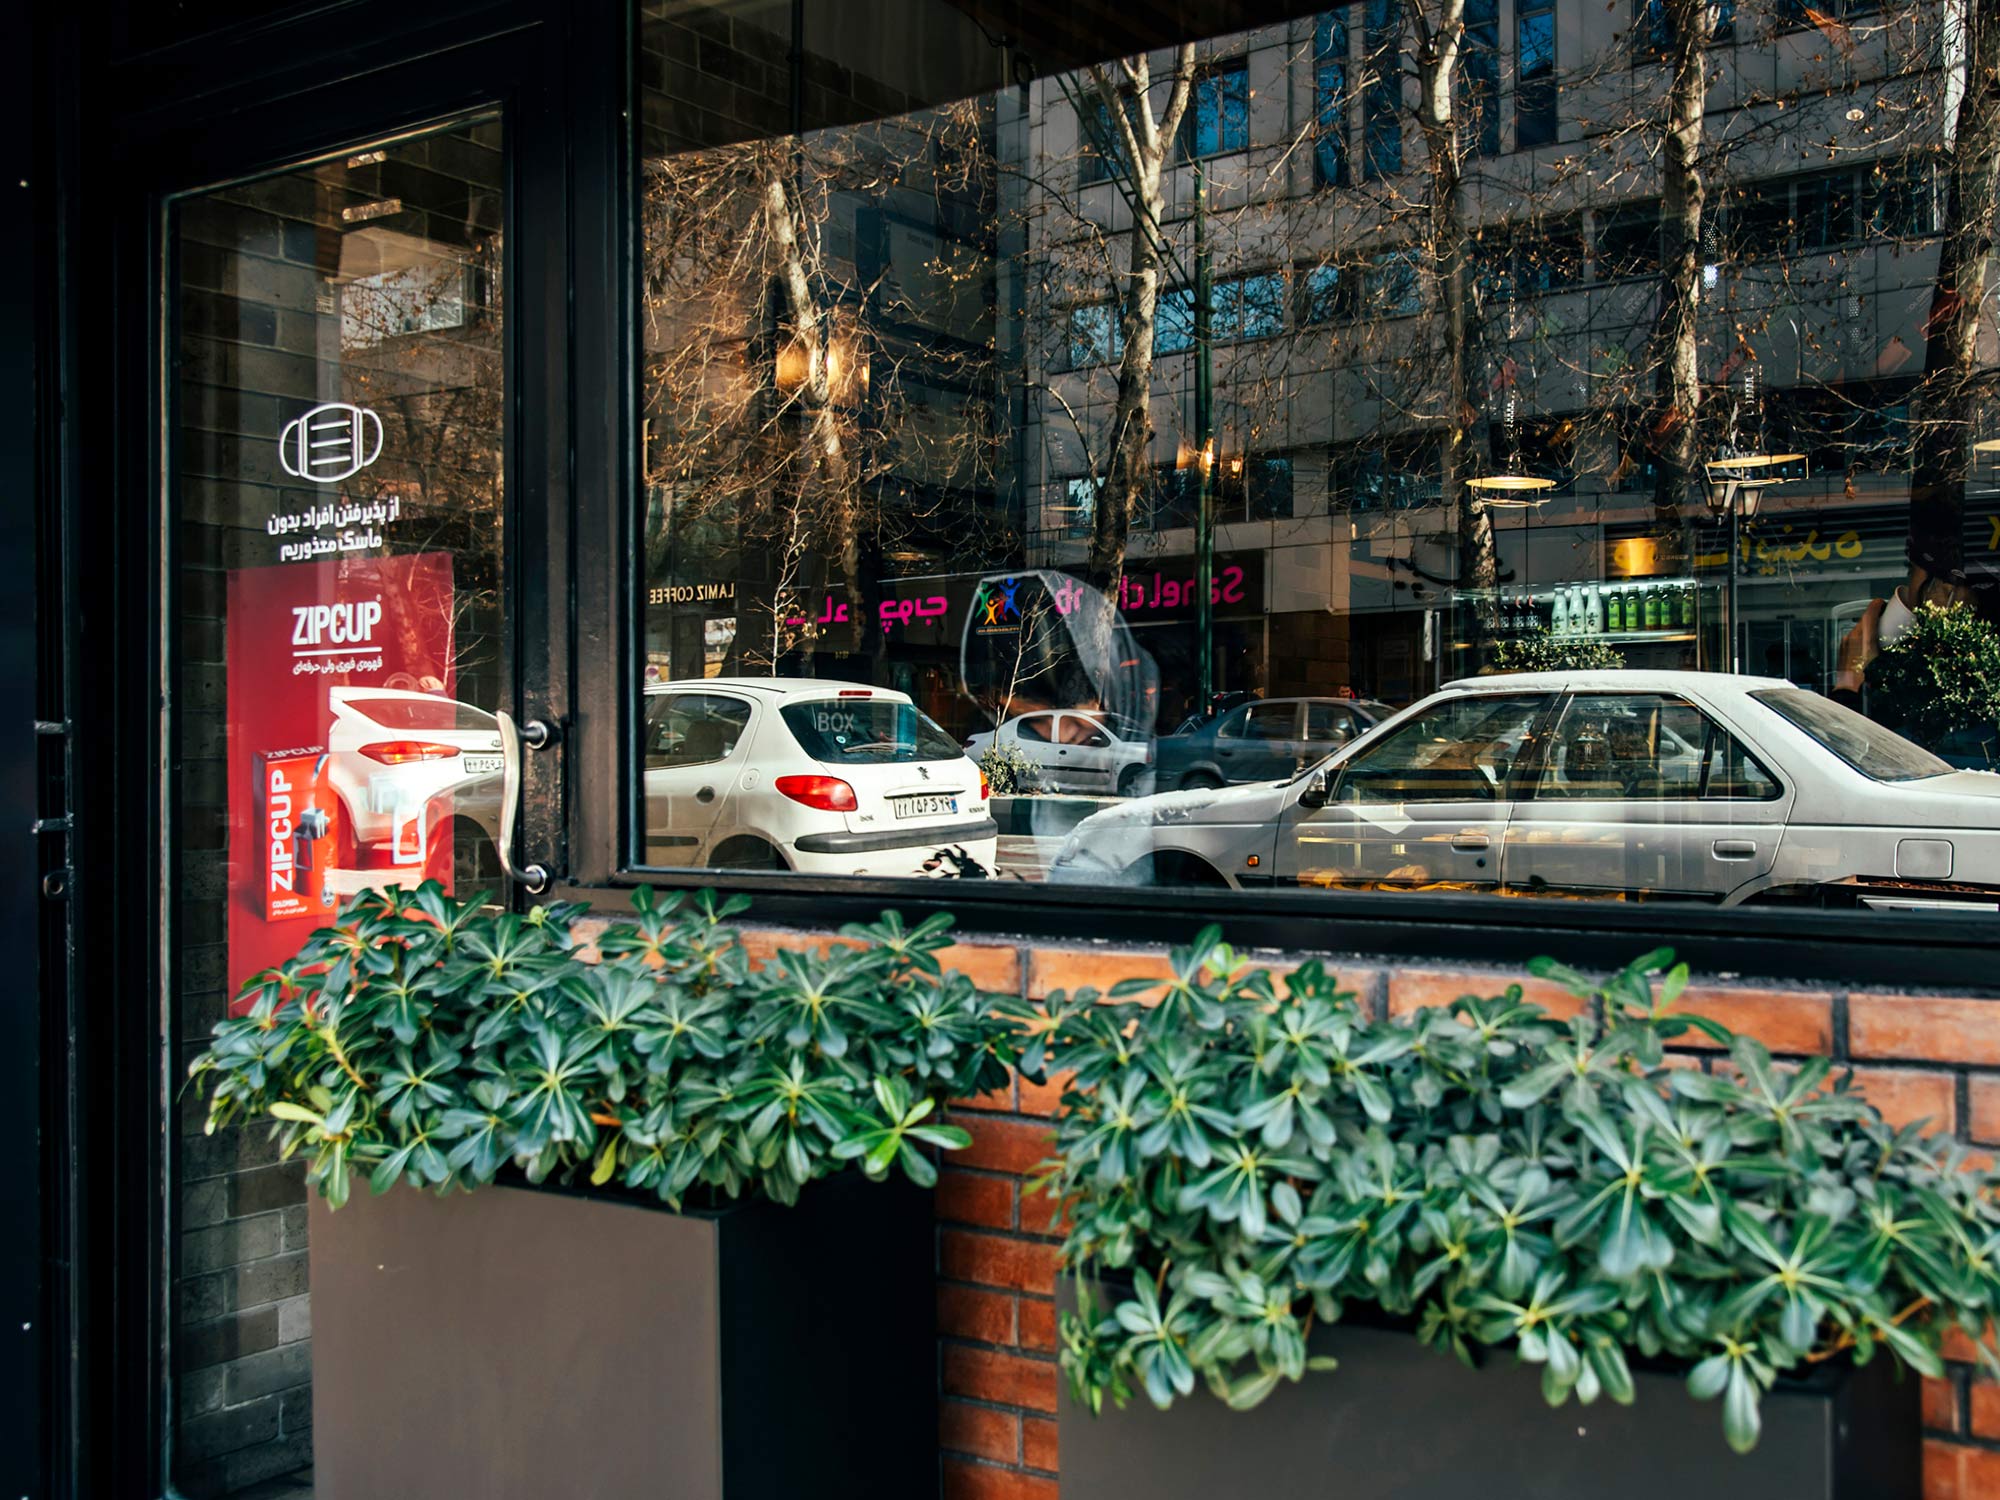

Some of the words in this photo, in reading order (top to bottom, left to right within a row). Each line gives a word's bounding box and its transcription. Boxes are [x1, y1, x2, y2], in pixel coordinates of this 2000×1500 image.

[302, 504, 334, 530] افراد
[335, 500, 386, 527] پذیرفتن
[388, 496, 399, 522] از
[267, 514, 300, 535] بدون
[280, 538, 336, 561] معذوریم
[338, 528, 382, 552] ماسک
[292, 600, 382, 645] ZIPCUP
[817, 711, 856, 733] BOX
[266, 745, 325, 759] ZIPCUP
[271, 769, 293, 892] ZIPCUP
